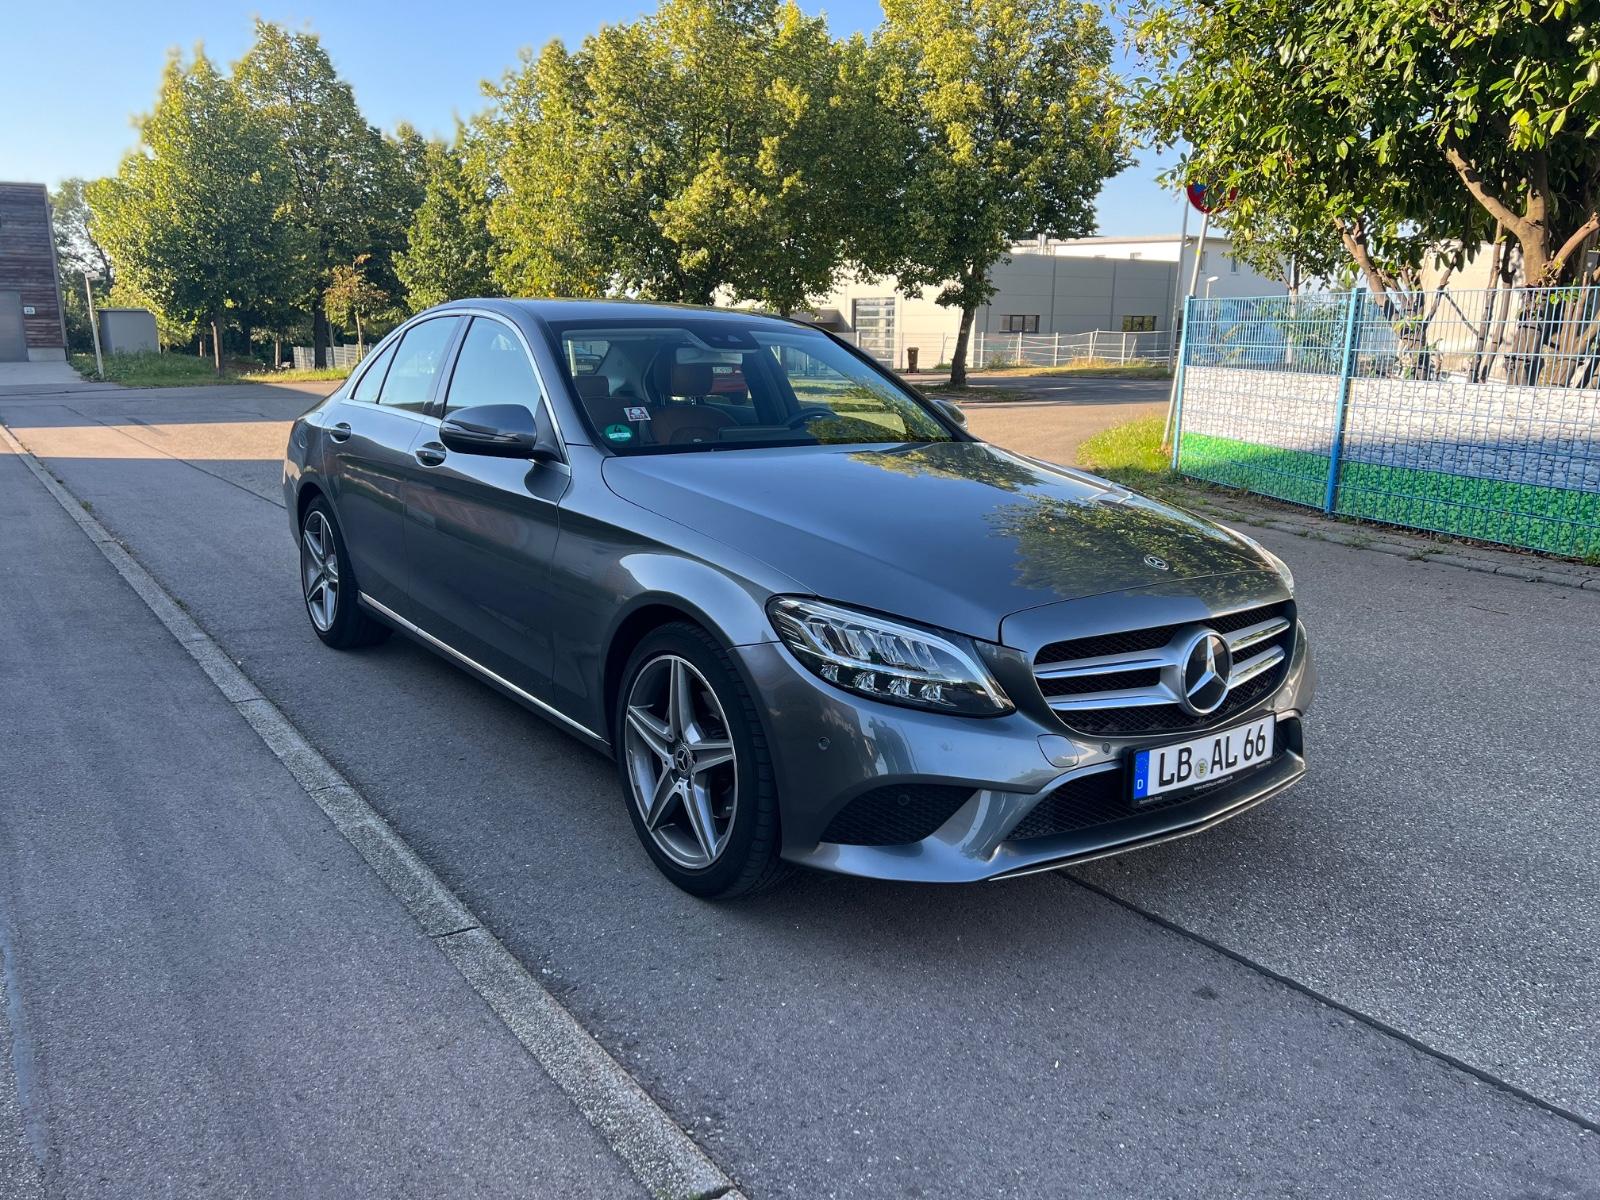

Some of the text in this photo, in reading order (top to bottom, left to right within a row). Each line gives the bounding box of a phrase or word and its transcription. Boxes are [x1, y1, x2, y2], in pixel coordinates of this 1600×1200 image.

[1159, 747, 1192, 787] LB
[1210, 736, 1238, 774] AL
[1244, 724, 1266, 761] 66
[1137, 779, 1144, 790] D
